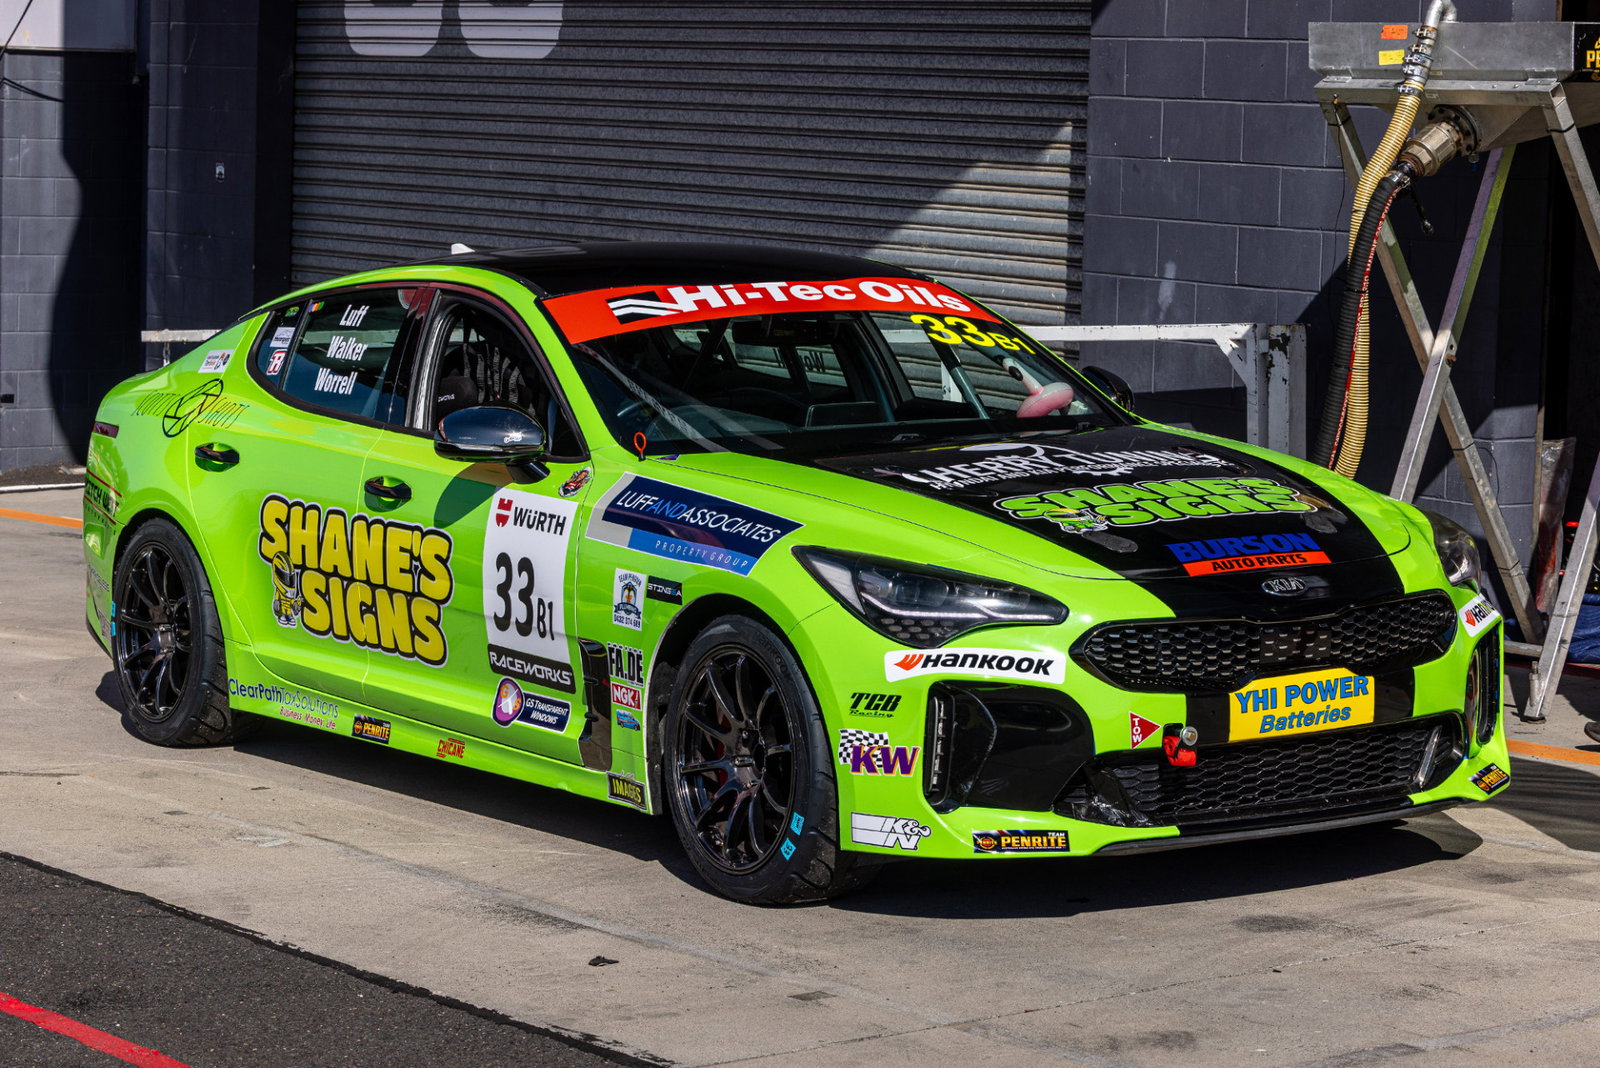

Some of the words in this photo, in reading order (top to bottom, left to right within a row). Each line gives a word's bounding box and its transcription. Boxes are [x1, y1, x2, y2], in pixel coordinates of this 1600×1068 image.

[666, 281, 857, 313] Hi-Tec
[859, 281, 971, 312] Oils
[339, 304, 370, 327] Luff
[910, 314, 996, 347] 33
[326, 336, 368, 361] Walker
[314, 368, 358, 395] Worrell
[999, 478, 1294, 518] SHANE'S
[1095, 493, 1313, 525] SIGNS
[259, 495, 453, 604] SHANE'S
[655, 540, 707, 559] PROPERTY
[709, 553, 748, 568] GROUP
[1164, 532, 1322, 563] BURSON
[1213, 556, 1256, 572] AUTO
[1257, 553, 1308, 567] PARTS
[493, 552, 535, 637] 33
[537, 598, 555, 641] B1
[1268, 577, 1304, 593] KIA
[301, 569, 446, 664] SIGNS
[489, 651, 571, 686] RACEWORKS
[534, 700, 568, 716] TRANSPARENT
[613, 686, 635, 706] NGK
[1235, 687, 1277, 713] YHI
[1285, 675, 1369, 707] POWER
[363, 722, 391, 739] PENRITE
[530, 710, 559, 724] WINDOWS
[1132, 717, 1142, 743] TOW
[1259, 705, 1352, 733] Batteries
[850, 744, 921, 777] KW
[612, 778, 642, 803] IMAGES
[1000, 836, 1067, 847] PENRITE
